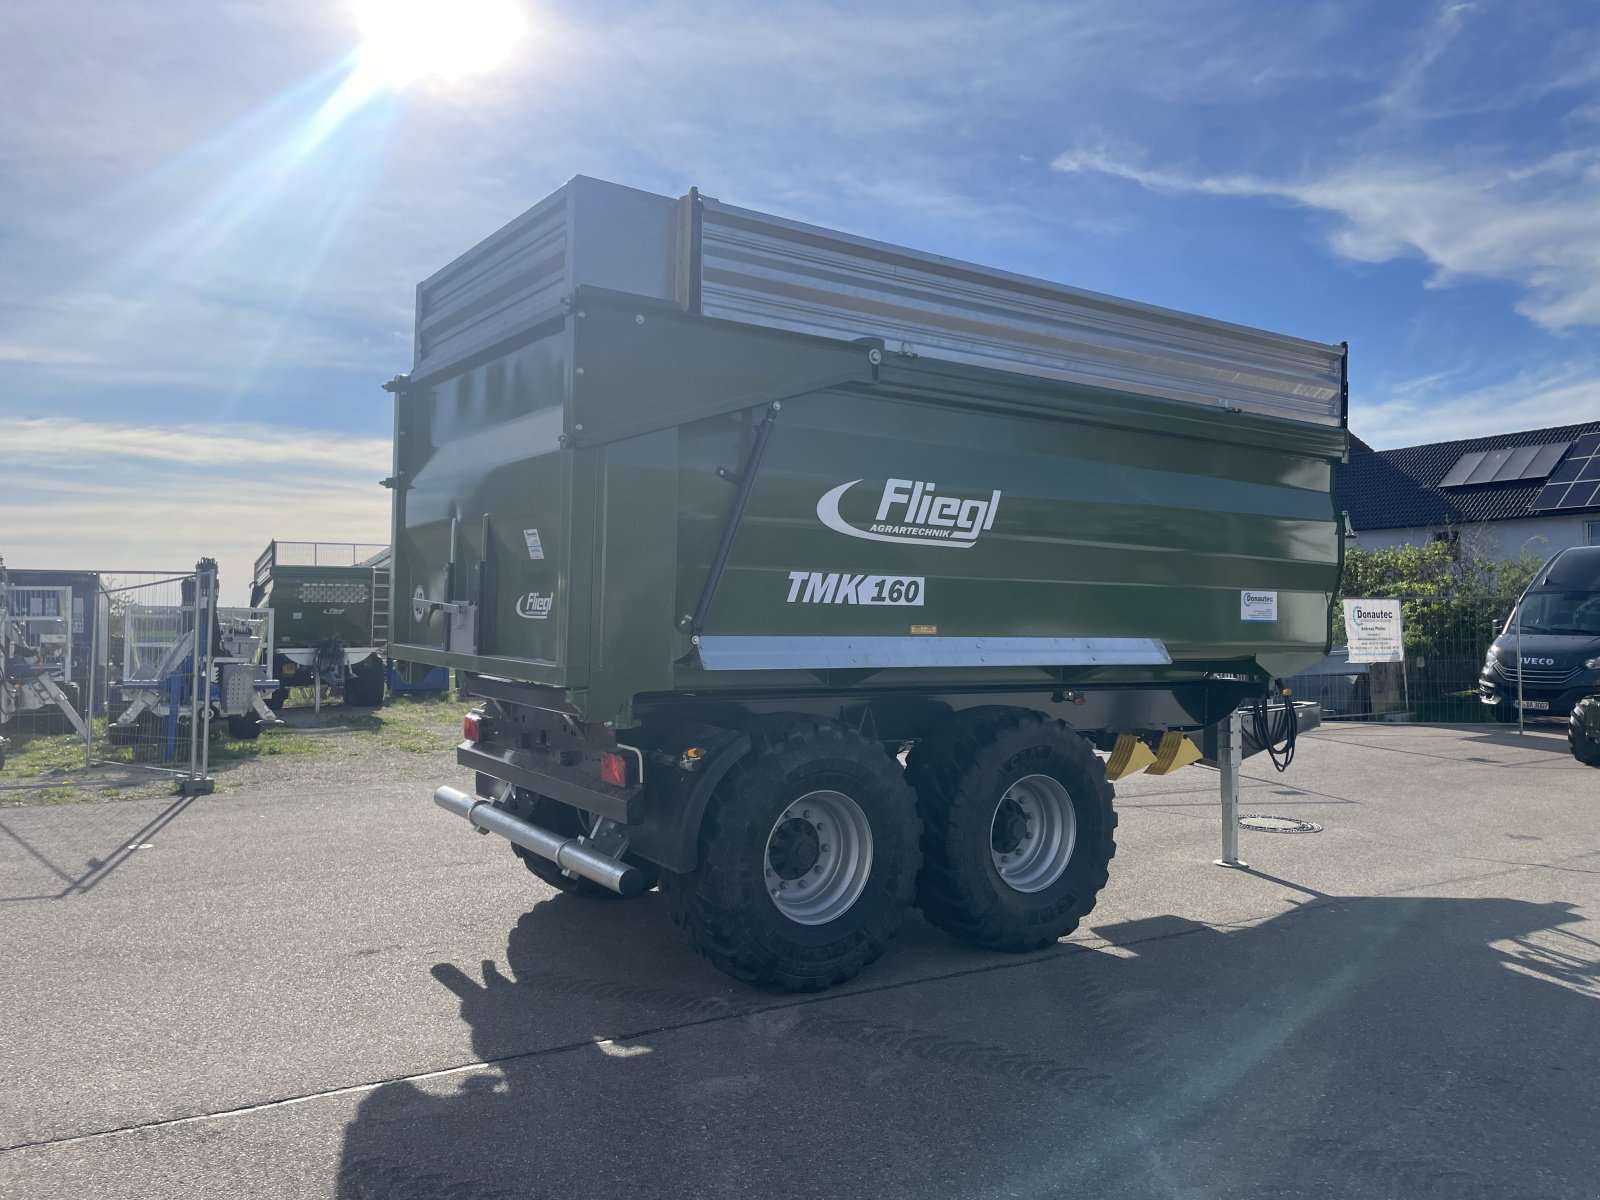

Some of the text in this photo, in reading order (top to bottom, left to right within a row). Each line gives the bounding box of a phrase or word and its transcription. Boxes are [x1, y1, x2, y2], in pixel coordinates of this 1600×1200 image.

[875, 478, 1002, 540] Fliegl
[869, 524, 951, 538] AGRARTECHNIK
[787, 571, 920, 605] TMK 160
[526, 592, 554, 615] Fliegl
[1246, 594, 1274, 602] Donautec
[1357, 609, 1393, 619] Donautec
[1520, 657, 1554, 665] IVECO
